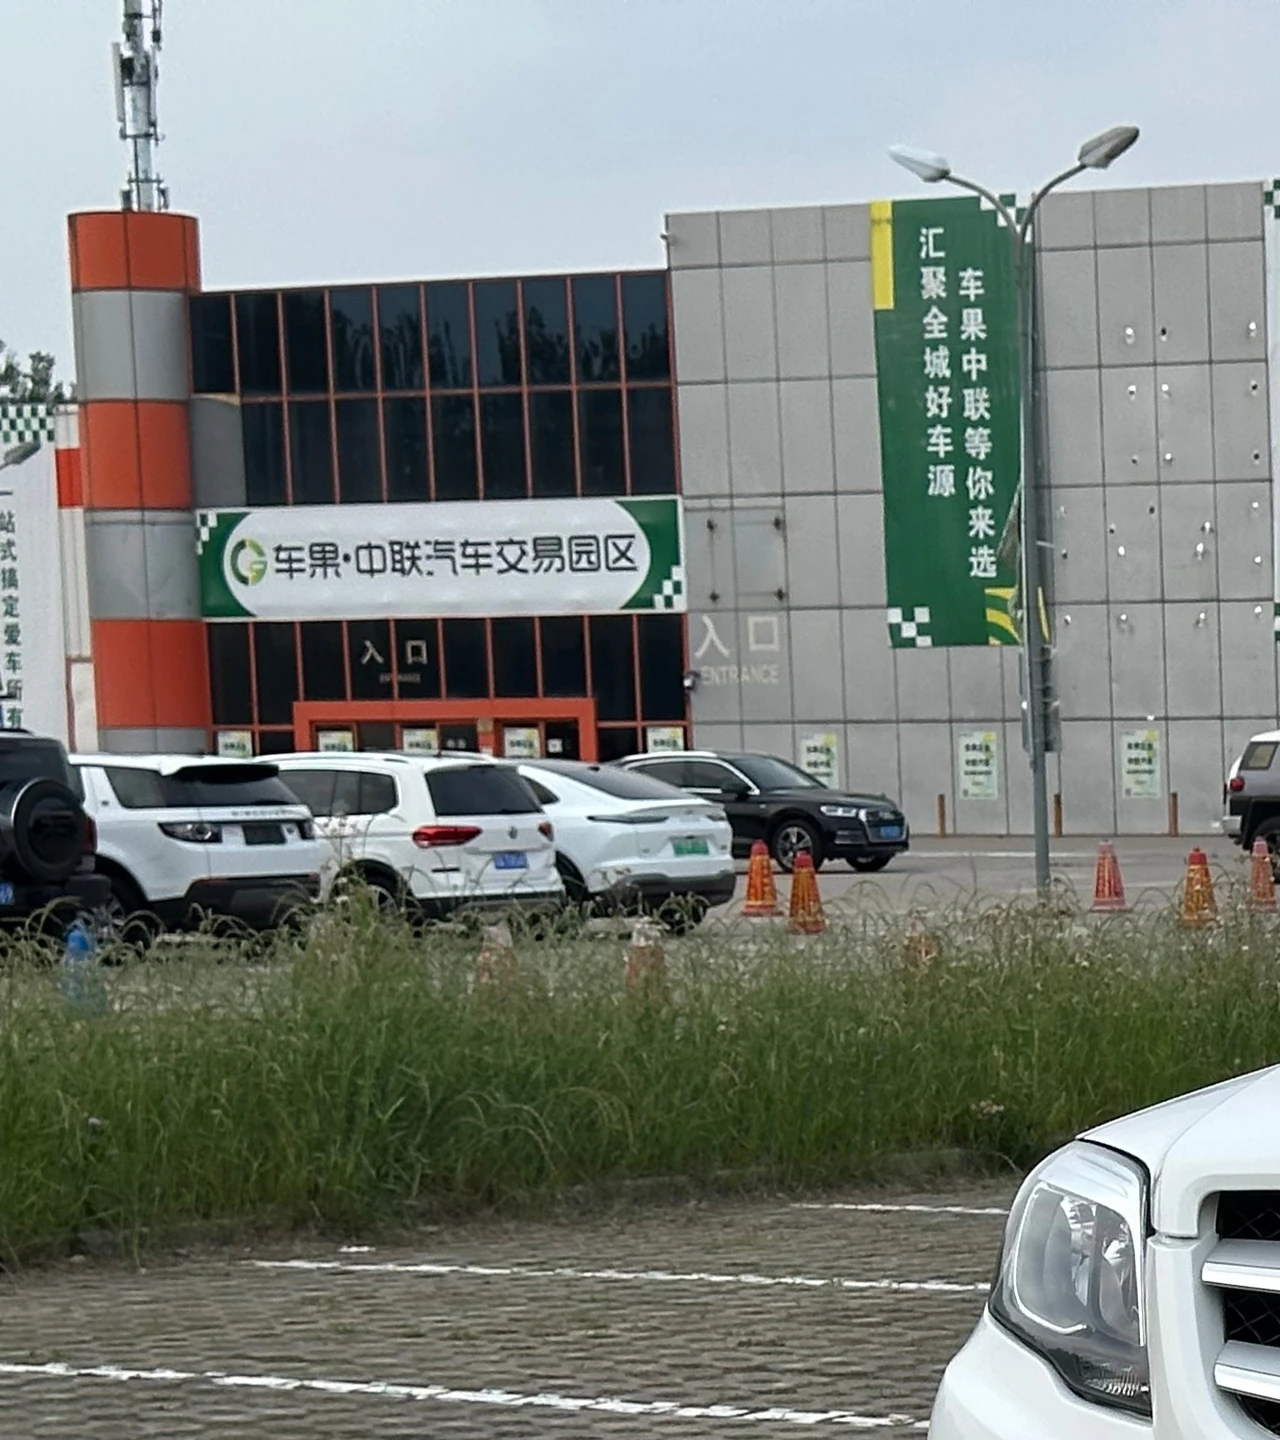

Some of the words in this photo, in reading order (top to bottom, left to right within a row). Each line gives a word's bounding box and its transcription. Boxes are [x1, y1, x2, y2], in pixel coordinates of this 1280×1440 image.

[919, 227, 956, 498] 汇聚全城好车源
[958, 267, 998, 578] 车果中联等你来选
[272, 533, 638, 580] 车果·中联汽车交易园区
[361, 639, 428, 665] 入口
[694, 614, 779, 658] 入口
[701, 662, 780, 686] ENTRANCE
